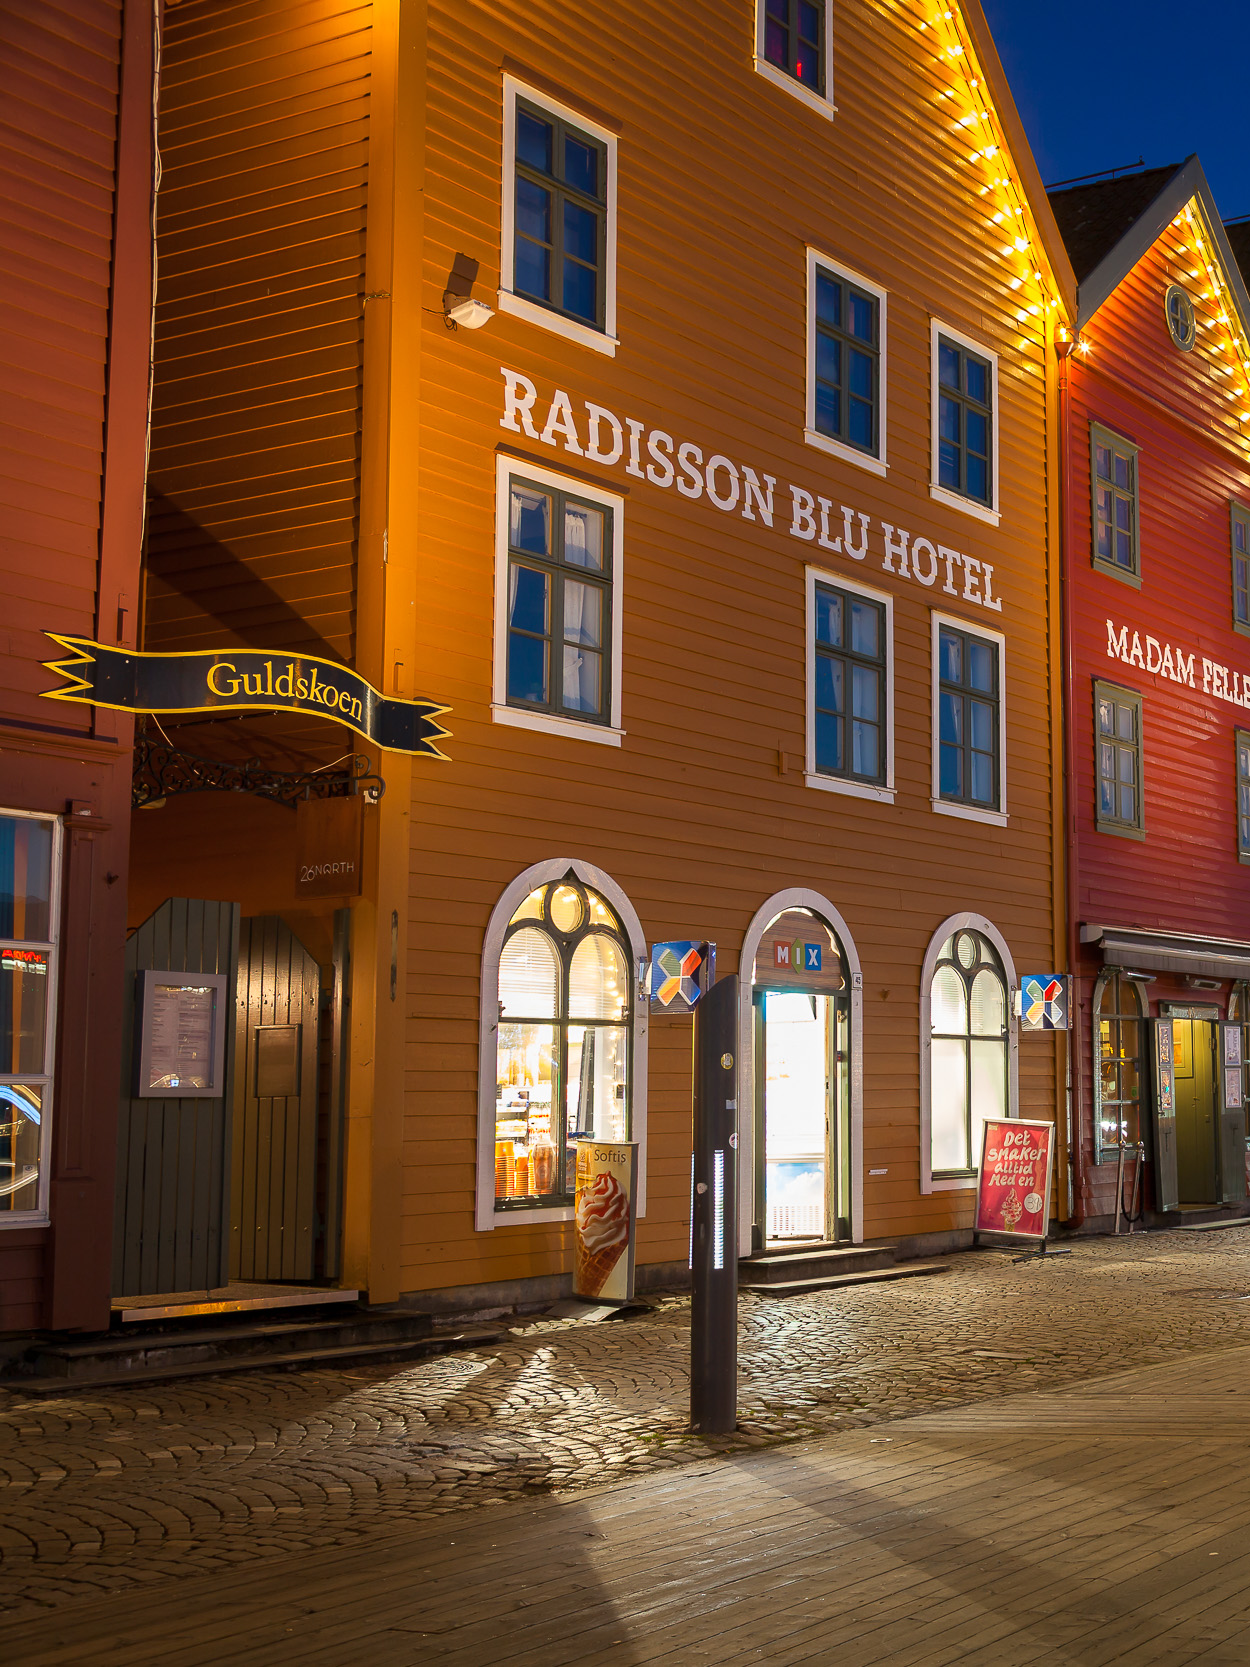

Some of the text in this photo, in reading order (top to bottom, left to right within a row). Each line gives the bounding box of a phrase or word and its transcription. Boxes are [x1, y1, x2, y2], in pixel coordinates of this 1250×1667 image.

[499, 366, 1003, 612] RADISSON BLU HOTEL
[1106, 618, 1196, 689] MADAM
[206, 660, 363, 722] Guldskoen
[777, 945, 818, 966] MIX
[1003, 1129, 1031, 1147] Det
[594, 1149, 627, 1163] Softis
[994, 1161, 1033, 1175] alltid
[1018, 1176, 1035, 1187] en
